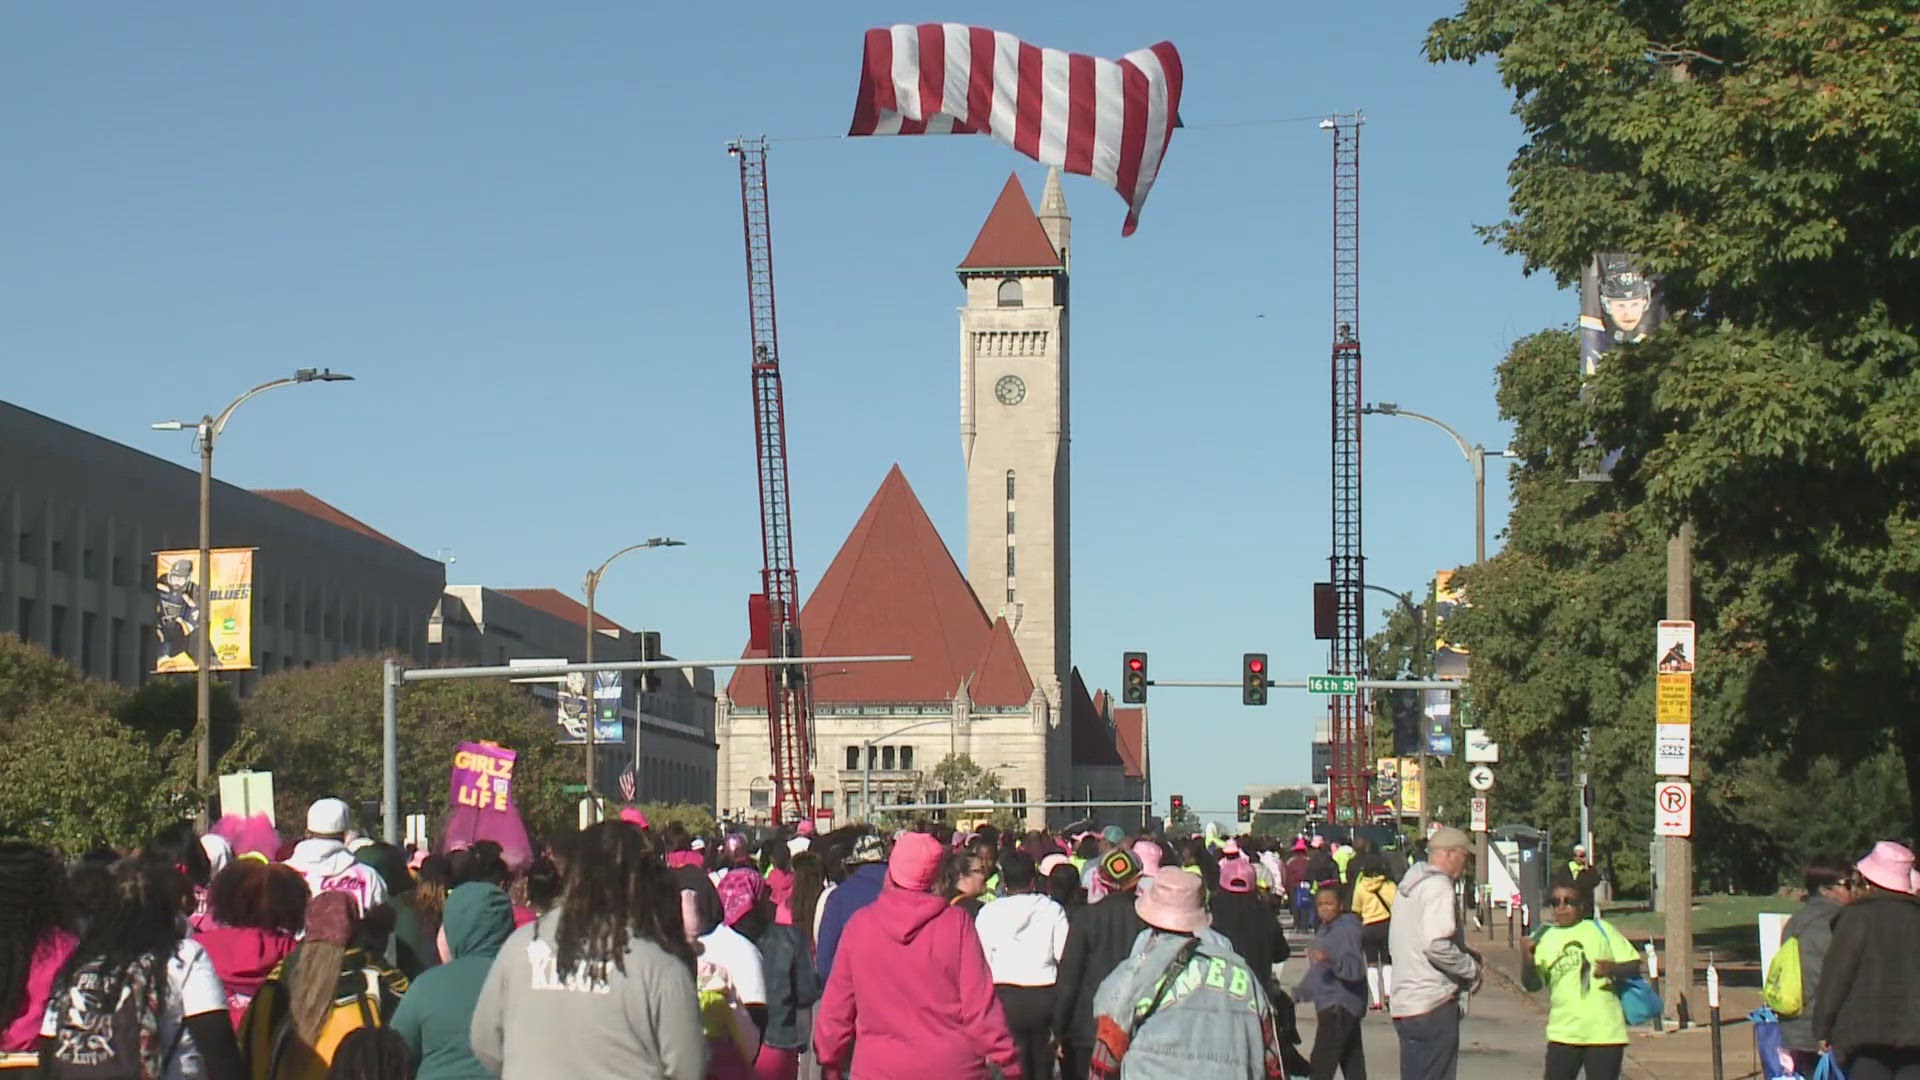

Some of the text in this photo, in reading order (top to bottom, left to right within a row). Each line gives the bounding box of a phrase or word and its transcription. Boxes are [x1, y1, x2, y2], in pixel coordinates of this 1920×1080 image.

[209, 588, 250, 601] BLUES
[1310, 679, 1355, 691] 16th St
[455, 751, 514, 780] GIRLZ
[475, 771, 491, 791] 4
[458, 785, 507, 812] LIFE
